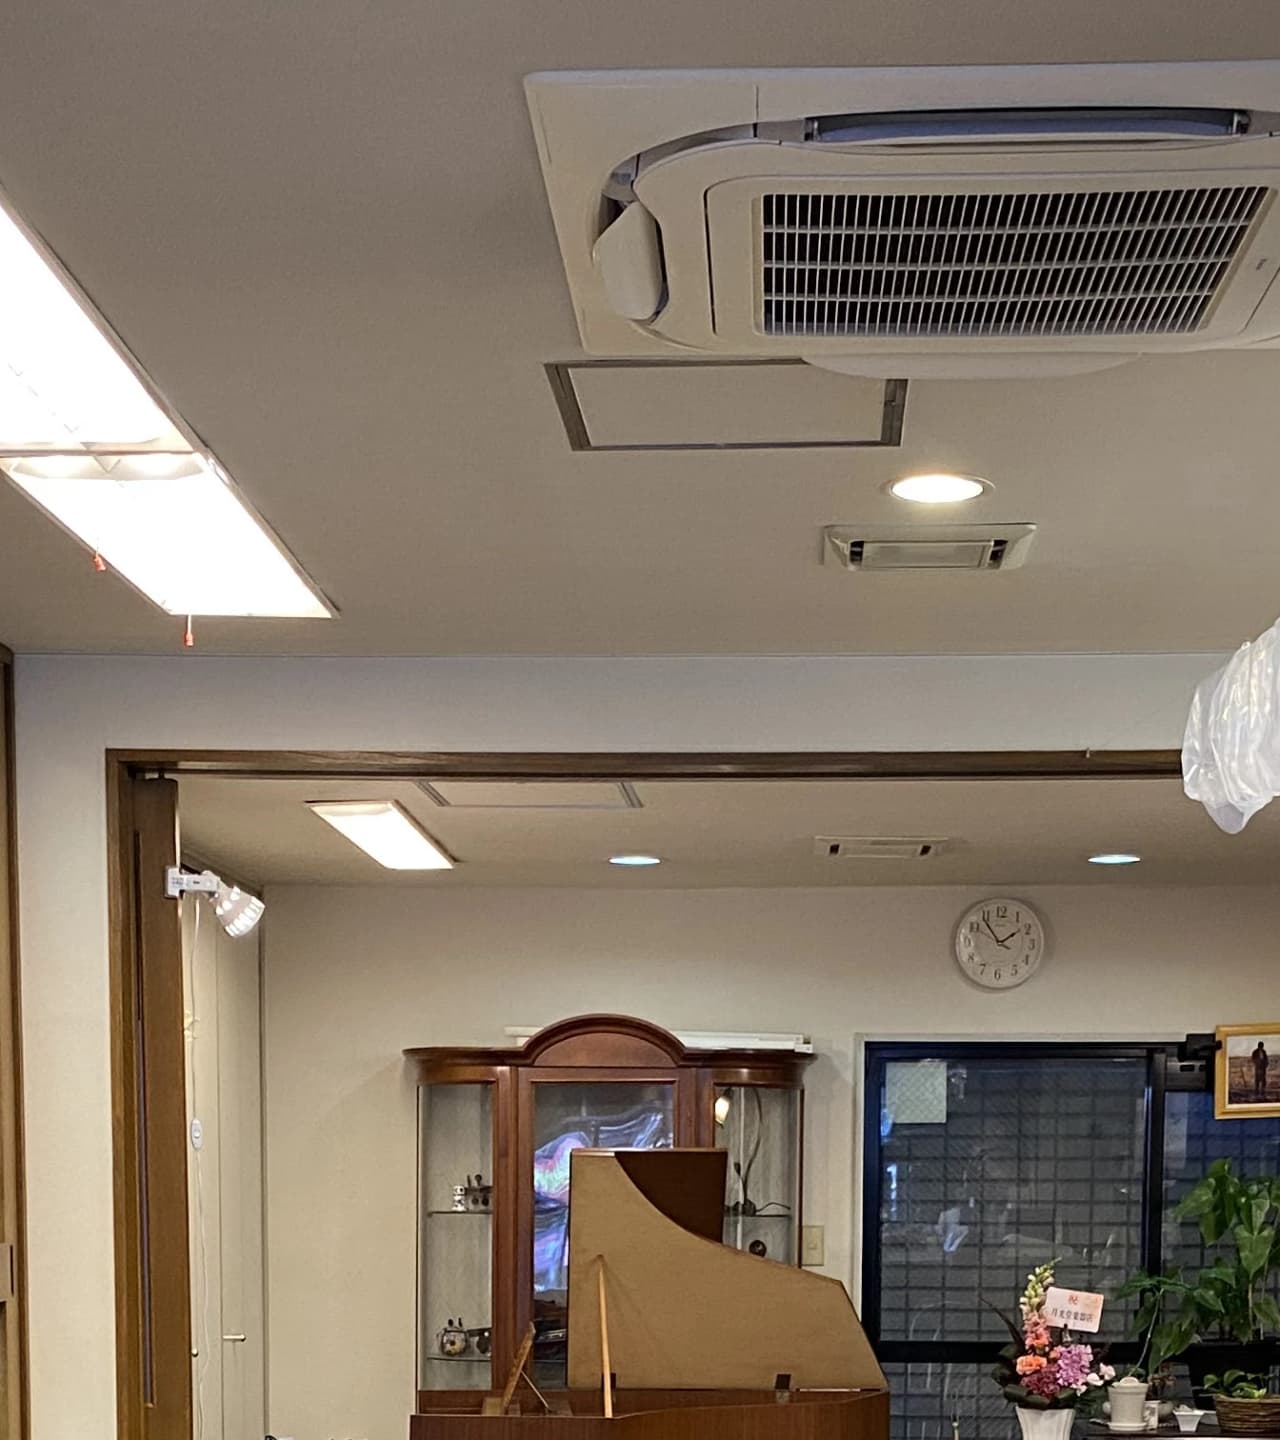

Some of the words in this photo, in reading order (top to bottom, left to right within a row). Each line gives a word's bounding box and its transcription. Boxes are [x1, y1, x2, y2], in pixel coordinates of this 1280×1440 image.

[996, 906, 1007, 918] 12
[1015, 911, 1020, 923] 1
[1024, 923, 1032, 935] 2
[1028, 938, 1035, 950] 3
[1022, 954, 1029, 966] 4
[979, 963, 986, 975] 7
[994, 968, 1001, 981] 6
[1011, 964, 1018, 976] 5
